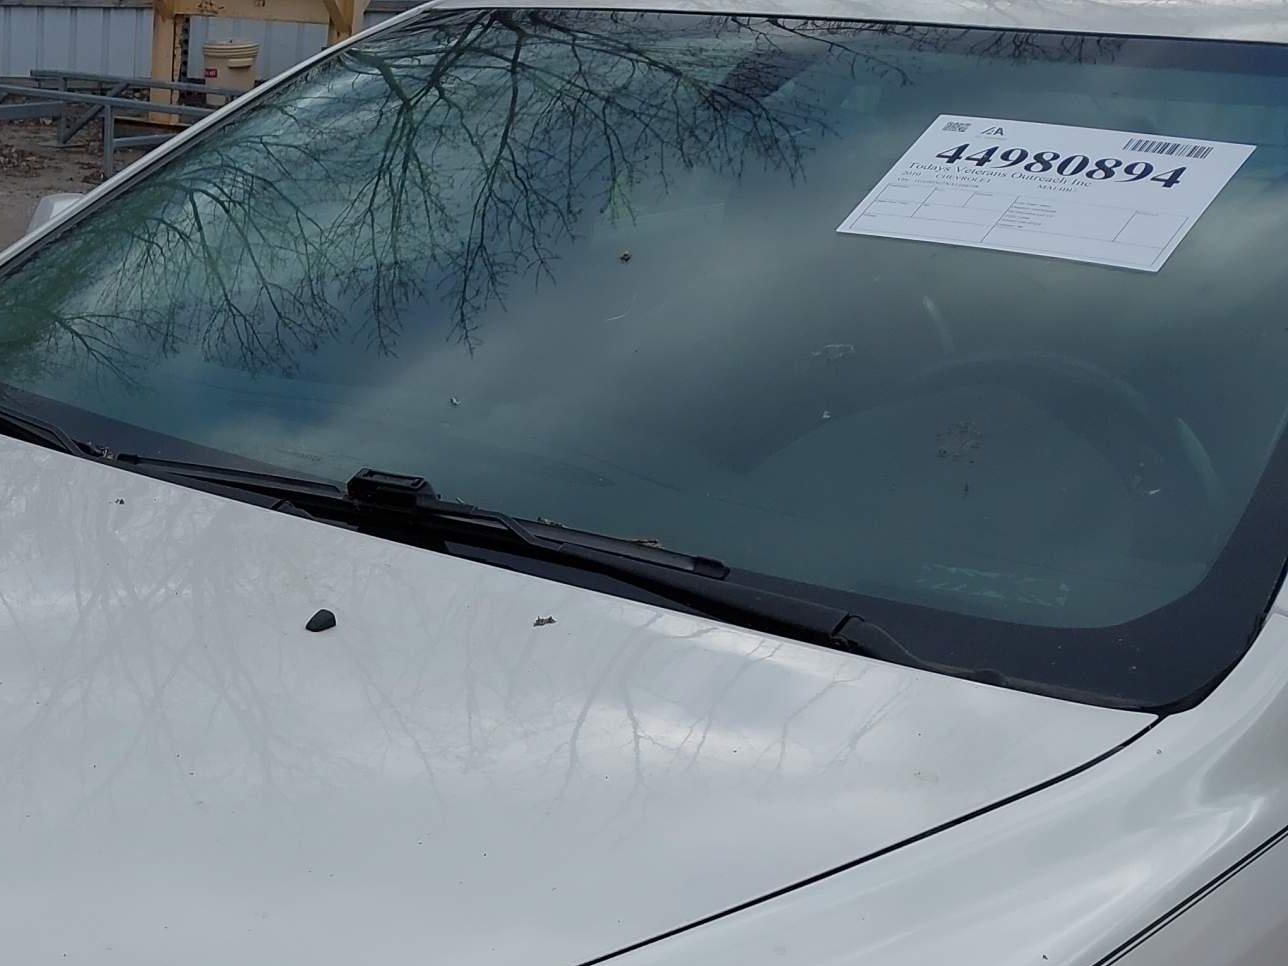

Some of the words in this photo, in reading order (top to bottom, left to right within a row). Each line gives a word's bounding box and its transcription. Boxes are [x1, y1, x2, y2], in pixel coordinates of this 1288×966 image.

[909, 162, 952, 173] Todays
[956, 166, 1007, 178] Veterans
[1011, 172, 1068, 185] Outreach
[1071, 179, 1092, 187] Inc
[935, 143, 1187, 188] 44980894
[935, 174, 992, 184] CHEVROLET
